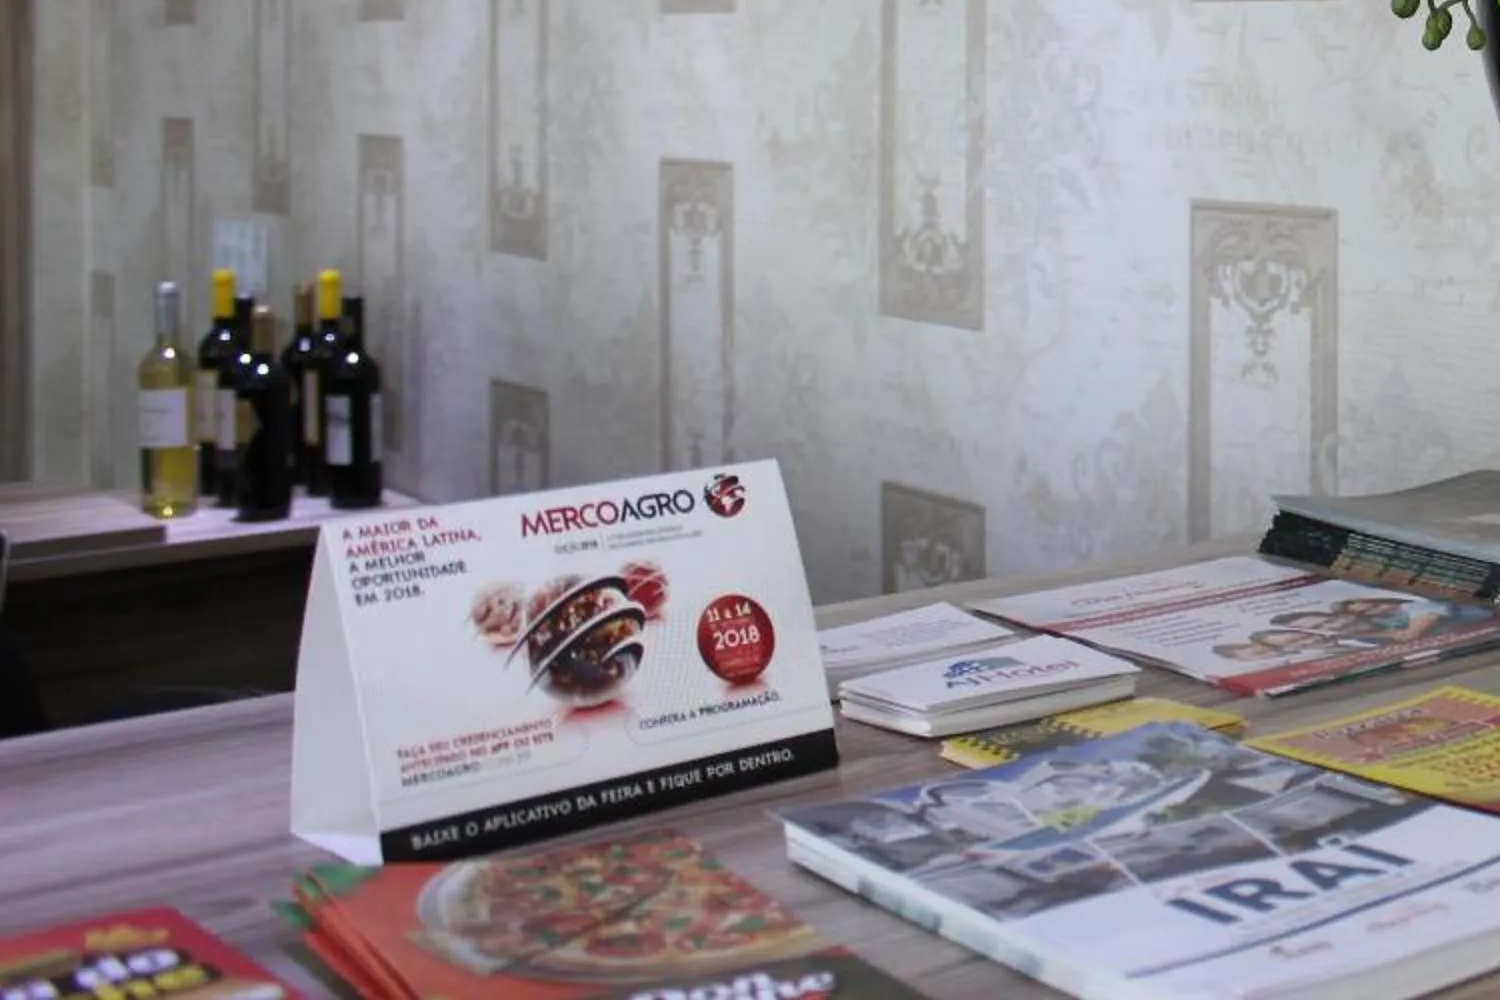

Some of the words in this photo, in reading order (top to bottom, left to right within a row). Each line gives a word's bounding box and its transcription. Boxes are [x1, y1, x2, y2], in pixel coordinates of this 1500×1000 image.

[521, 488, 696, 538] MERCOAGRO
[359, 520, 411, 538] MAIOR
[416, 516, 438, 531] DA
[365, 551, 425, 571] MELHOR
[351, 560, 467, 591] OPORTUNIDADE
[355, 592, 378, 607] EM
[706, 607, 721, 623] 11
[713, 624, 760, 651] 2018
[410, 825, 461, 851] BAIXE
[465, 822, 479, 838] O
[483, 800, 573, 833] APLICATIVO
[576, 795, 598, 811] DA
[600, 784, 642, 804] FEIRA
[646, 780, 656, 794] E
[660, 768, 703, 790] FIQUE
[706, 761, 736, 779] POR
[739, 748, 796, 774] DENTRO.
